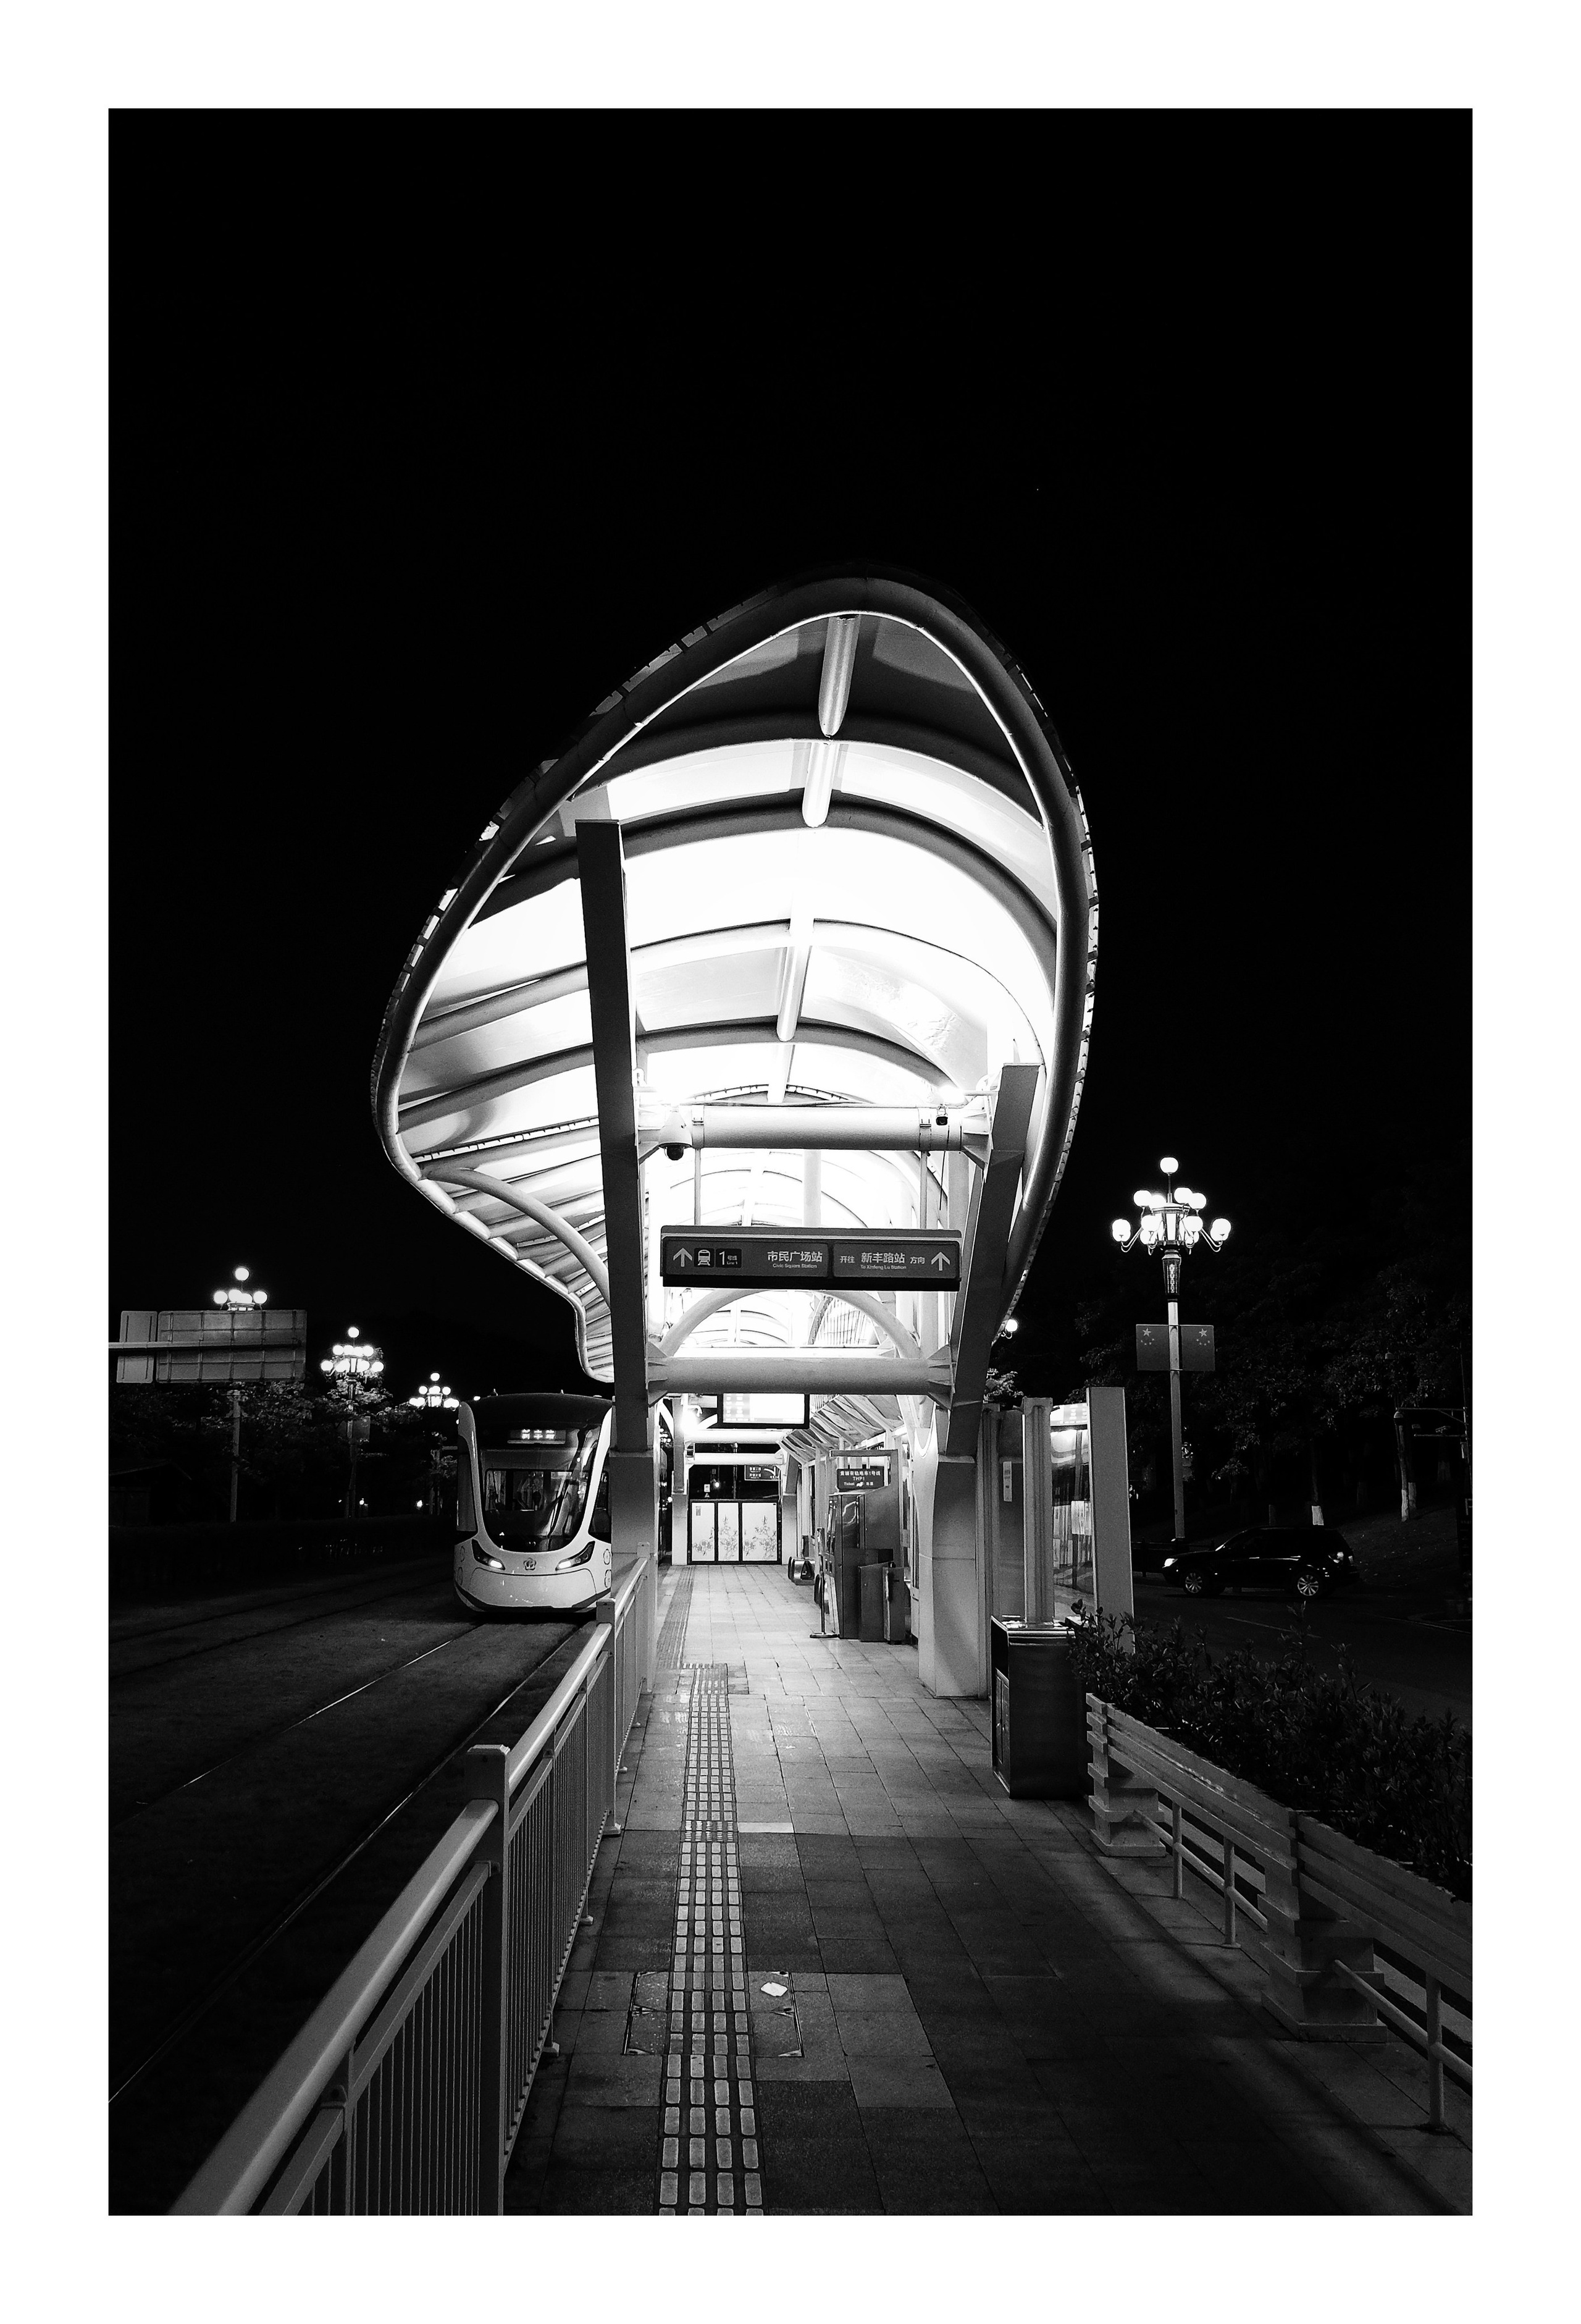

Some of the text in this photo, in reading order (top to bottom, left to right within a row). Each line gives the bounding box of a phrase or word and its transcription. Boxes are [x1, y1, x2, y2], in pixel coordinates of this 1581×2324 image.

[719, 1251, 725, 1265] 1
[767, 1250, 823, 1262] 市民广场站
[840, 1255, 855, 1263] 开往
[861, 1252, 905, 1263] 新丰路站
